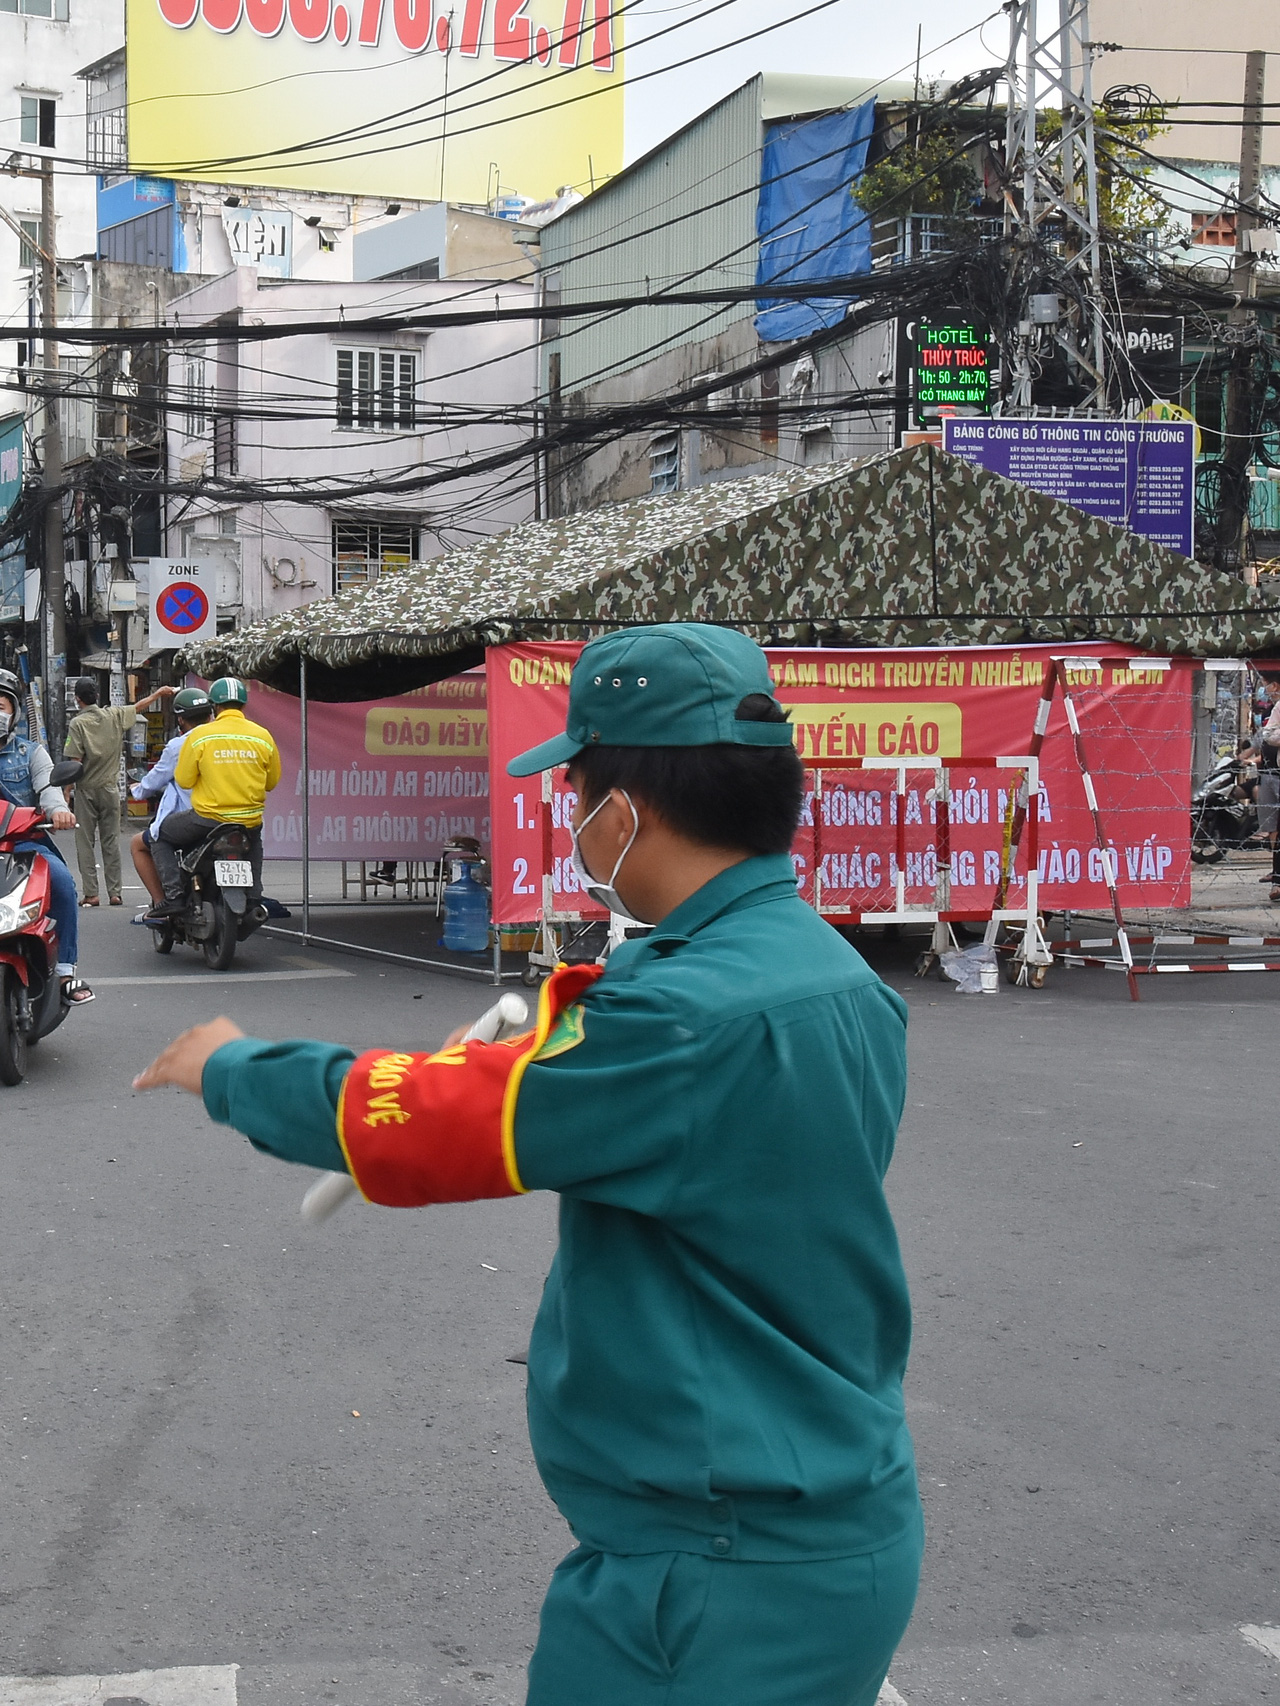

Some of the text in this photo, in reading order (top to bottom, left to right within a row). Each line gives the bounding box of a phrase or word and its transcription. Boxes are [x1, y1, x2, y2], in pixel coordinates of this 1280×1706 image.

[927, 330, 979, 344] HOTEL
[921, 344, 985, 367] THỦY TRÚC
[938, 371, 951, 384] 50
[921, 387, 985, 401] CÓ THANG MÁY
[953, 422, 1185, 443] BẢNG CÔNG BỐ THÔNG TIN CÔNG TRƯỜNG
[168, 565, 200, 576] ZONE
[509, 656, 572, 691] QUẬN
[771, 652, 1042, 693] TÂM DỊCH TRUYỀN NHIỄM
[877, 715, 940, 756] CÁO
[513, 793, 535, 829] 1.
[220, 861, 246, 874] 52-Y4
[1125, 833, 1173, 882] VẤP
[221, 874, 248, 885] 4873
[512, 856, 535, 894] 2.
